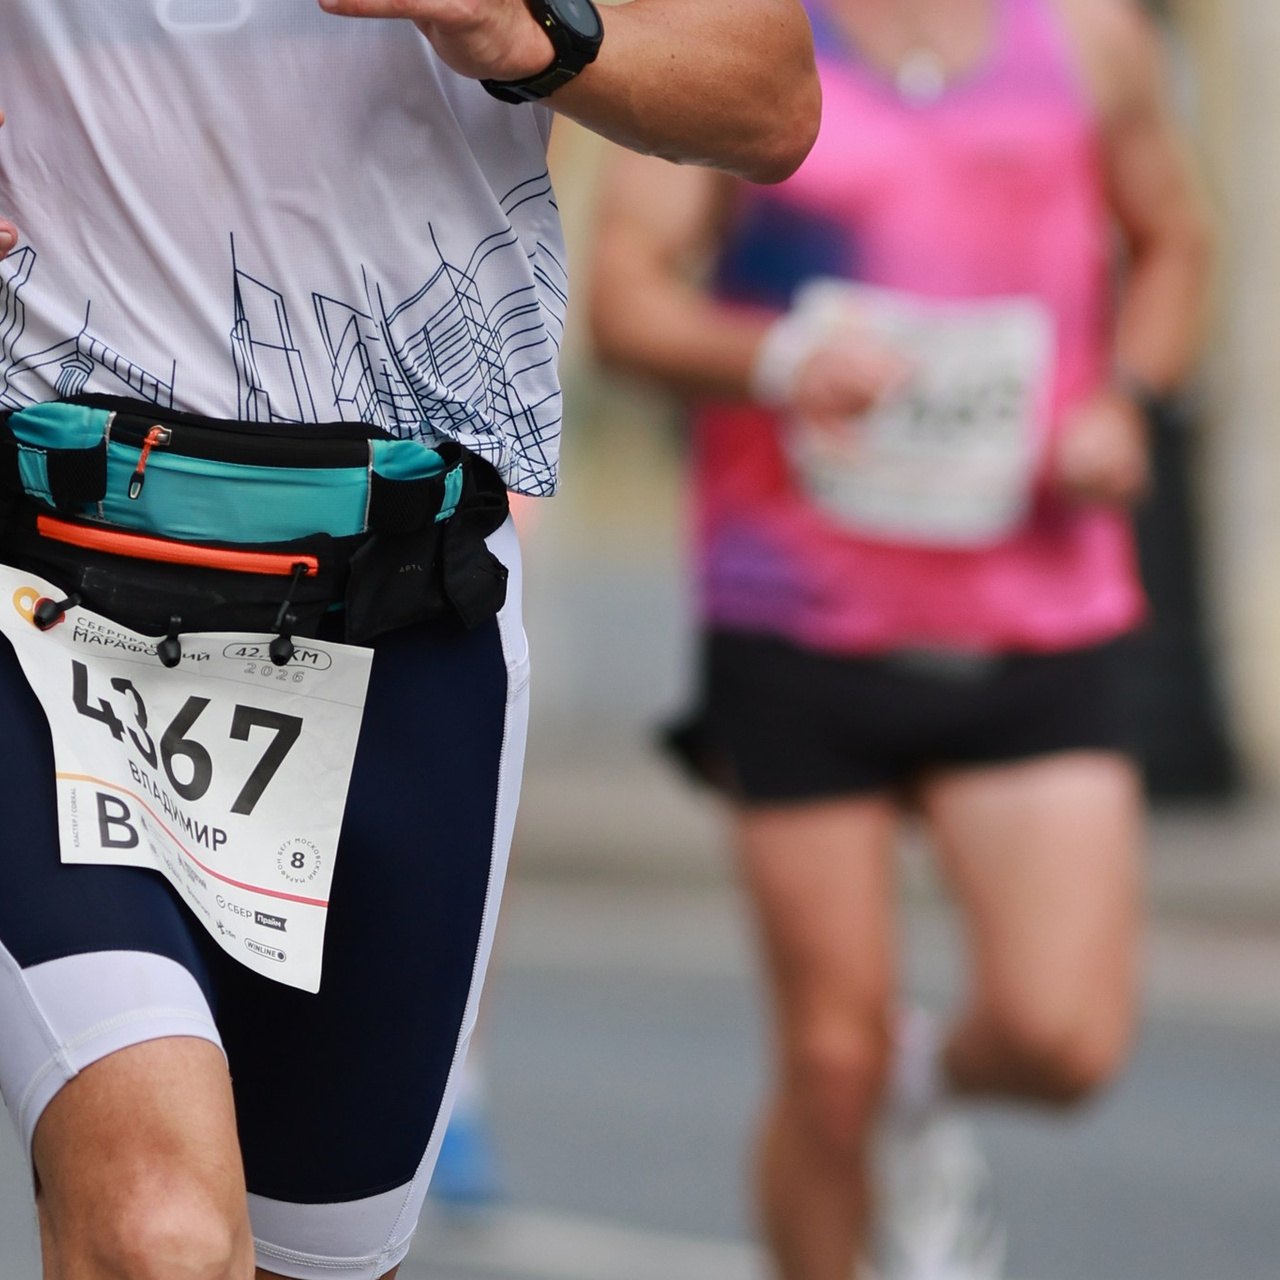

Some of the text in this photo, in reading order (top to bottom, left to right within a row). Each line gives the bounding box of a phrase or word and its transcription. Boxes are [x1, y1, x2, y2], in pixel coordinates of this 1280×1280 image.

[244, 663, 305, 683] 2026
[71, 659, 304, 816] 4367
[127, 759, 228, 852] ВЛАДИМИР
[290, 851, 305, 869] 8
[227, 902, 252, 918] СБЕР
[247, 941, 277, 957] WINLINE
